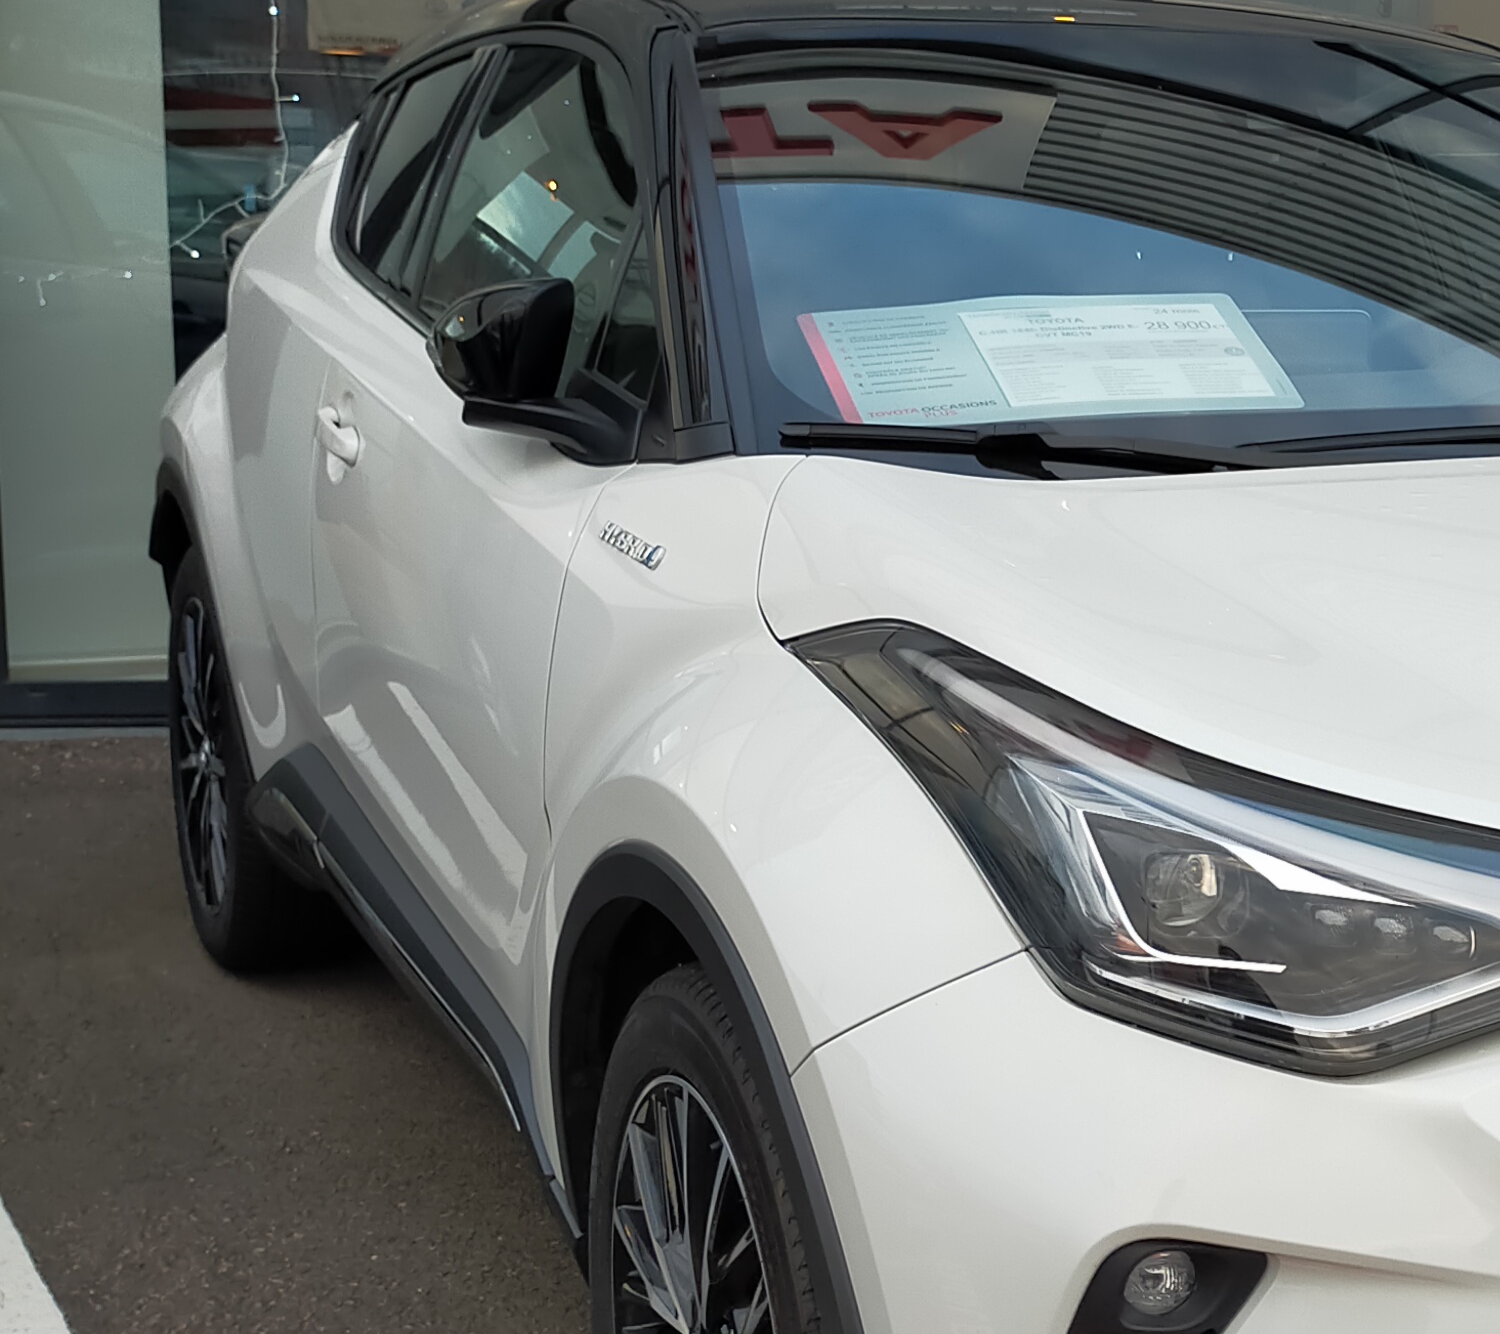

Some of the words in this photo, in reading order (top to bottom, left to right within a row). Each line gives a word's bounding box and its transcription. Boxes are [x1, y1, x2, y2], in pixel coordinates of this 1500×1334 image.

[1144, 321, 1169, 330] 28
[868, 408, 920, 419] TOYOTA
[921, 399, 998, 413] OCCASIONS
[924, 409, 958, 419] PLUS
